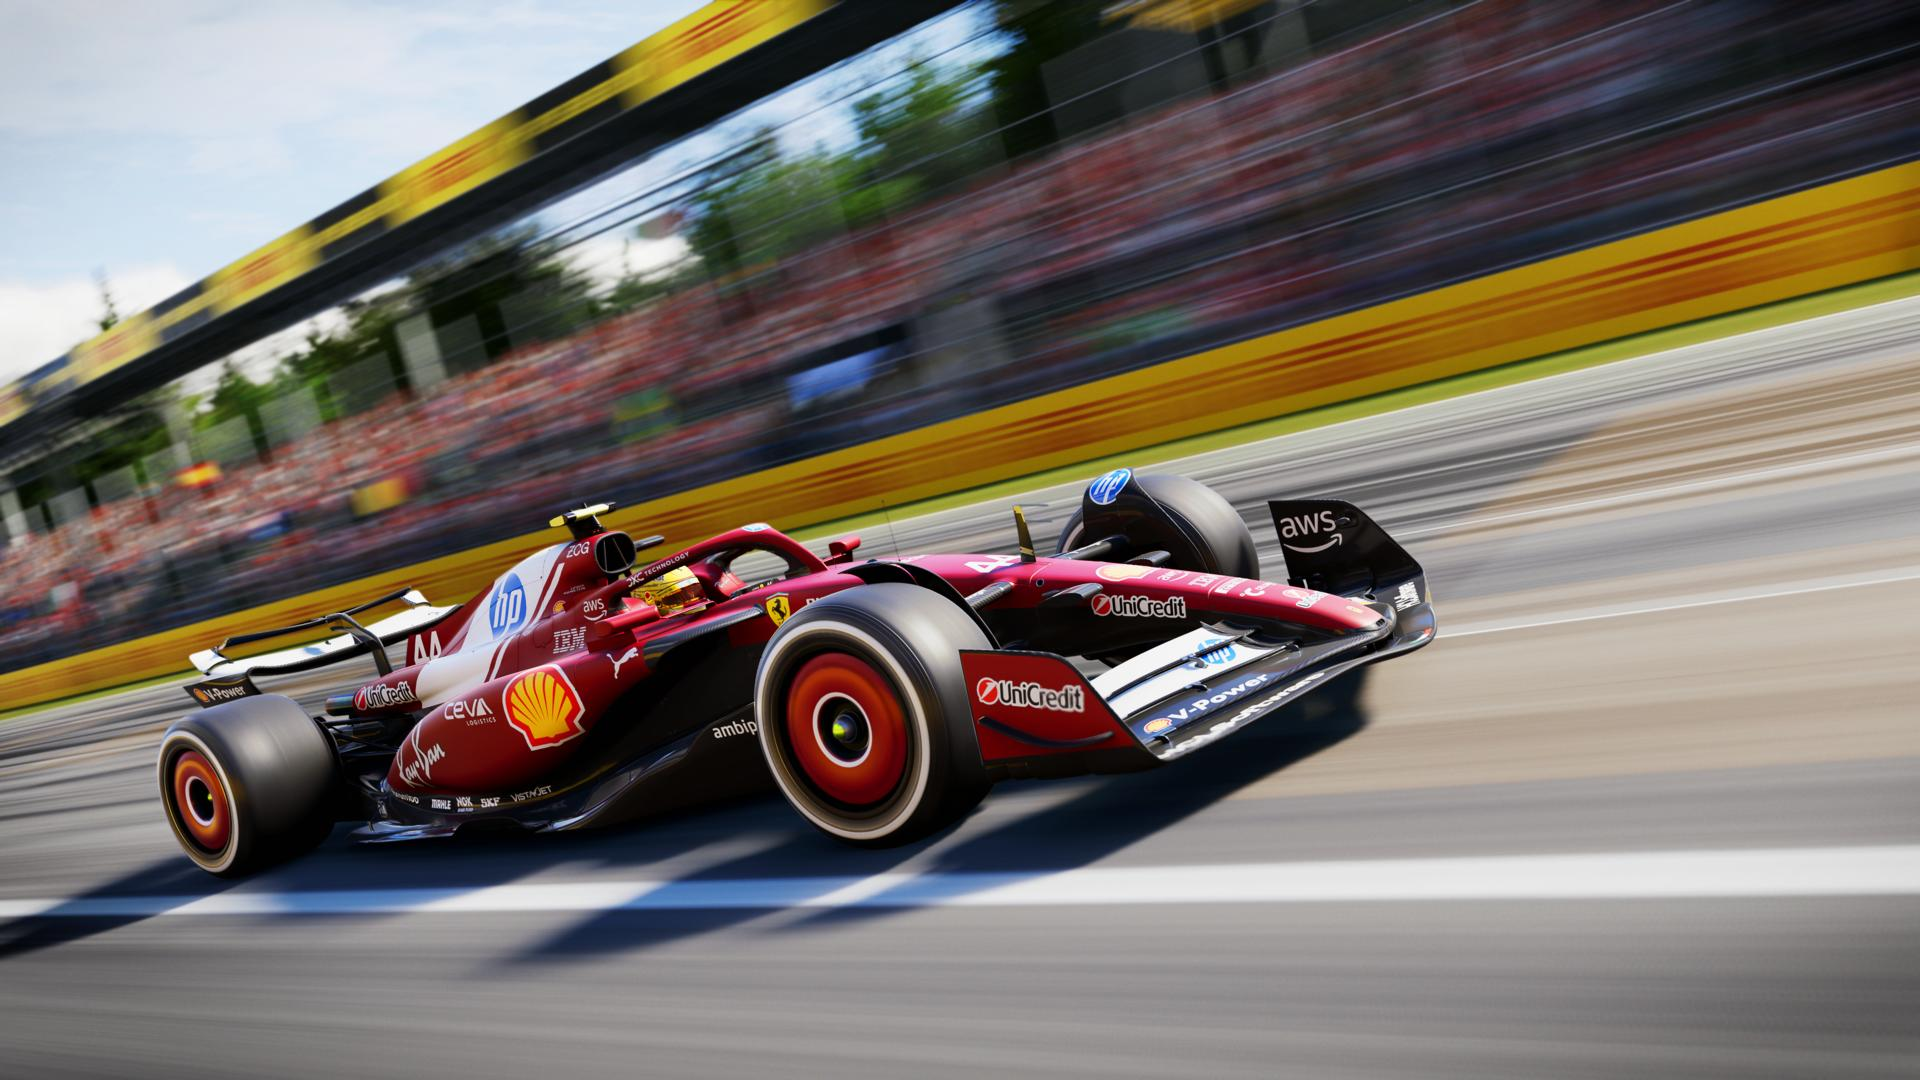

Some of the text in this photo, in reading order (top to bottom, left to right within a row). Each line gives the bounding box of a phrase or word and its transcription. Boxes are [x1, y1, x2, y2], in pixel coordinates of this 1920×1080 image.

[1093, 470, 1127, 504] hp
[1280, 511, 1336, 538] aws
[567, 542, 590, 558] ZCG
[644, 551, 689, 576] TECHNOLOGY
[491, 573, 524, 638] hp
[584, 598, 605, 613] aws
[1112, 596, 1185, 617] UniCredit
[553, 627, 587, 654] IBM
[204, 686, 246, 701] V-Power
[365, 682, 416, 708] UniCredit
[999, 681, 1082, 711] UniCredit
[1167, 674, 1269, 720] V-Power
[466, 717, 497, 727] LOGISTICS
[431, 799, 451, 810] MAHLE
[480, 797, 500, 808] SKF
